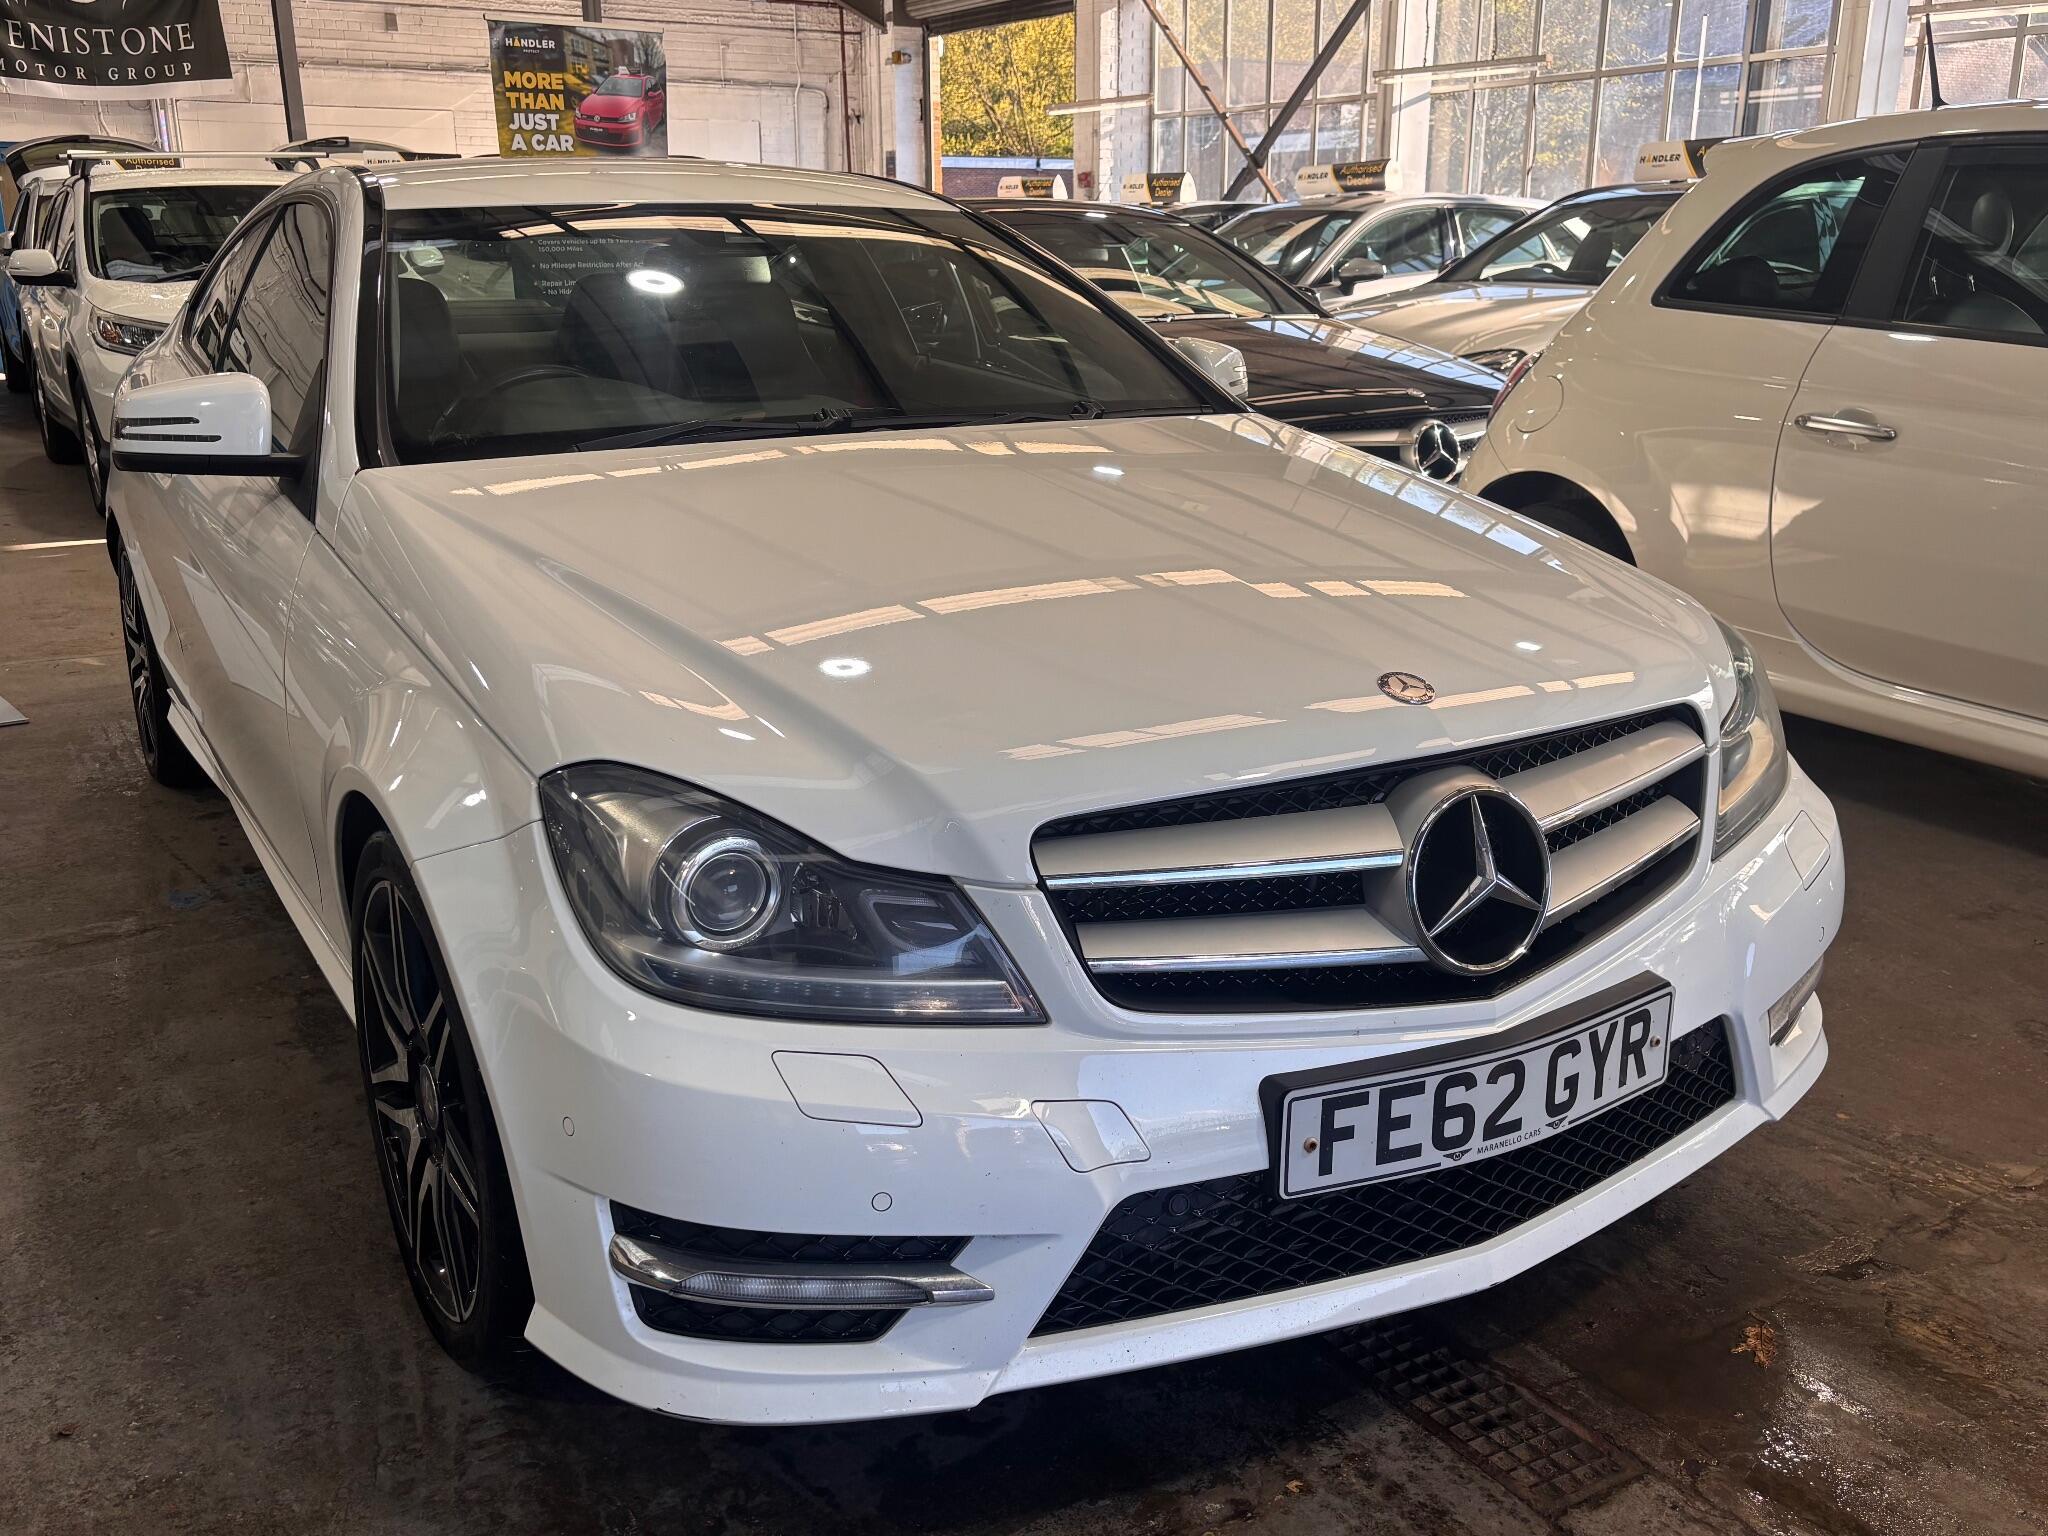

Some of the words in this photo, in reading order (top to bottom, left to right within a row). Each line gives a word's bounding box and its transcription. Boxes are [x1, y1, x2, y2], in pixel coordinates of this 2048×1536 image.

[108, 63, 192, 80] GROUP
[503, 71, 564, 90] MORE
[505, 92, 565, 110] THAN
[509, 113, 559, 131] JUST
[511, 134, 527, 150] A
[531, 134, 574, 151] CAR
[551, 262, 576, 270] Mileage
[541, 280, 562, 288] Repair
[1318, 1059, 1525, 1177] FE62
[1545, 1008, 1651, 1118] GYR
[1477, 1135, 1521, 1155] MARANELLO
[1524, 1127, 1541, 1140] CARS
